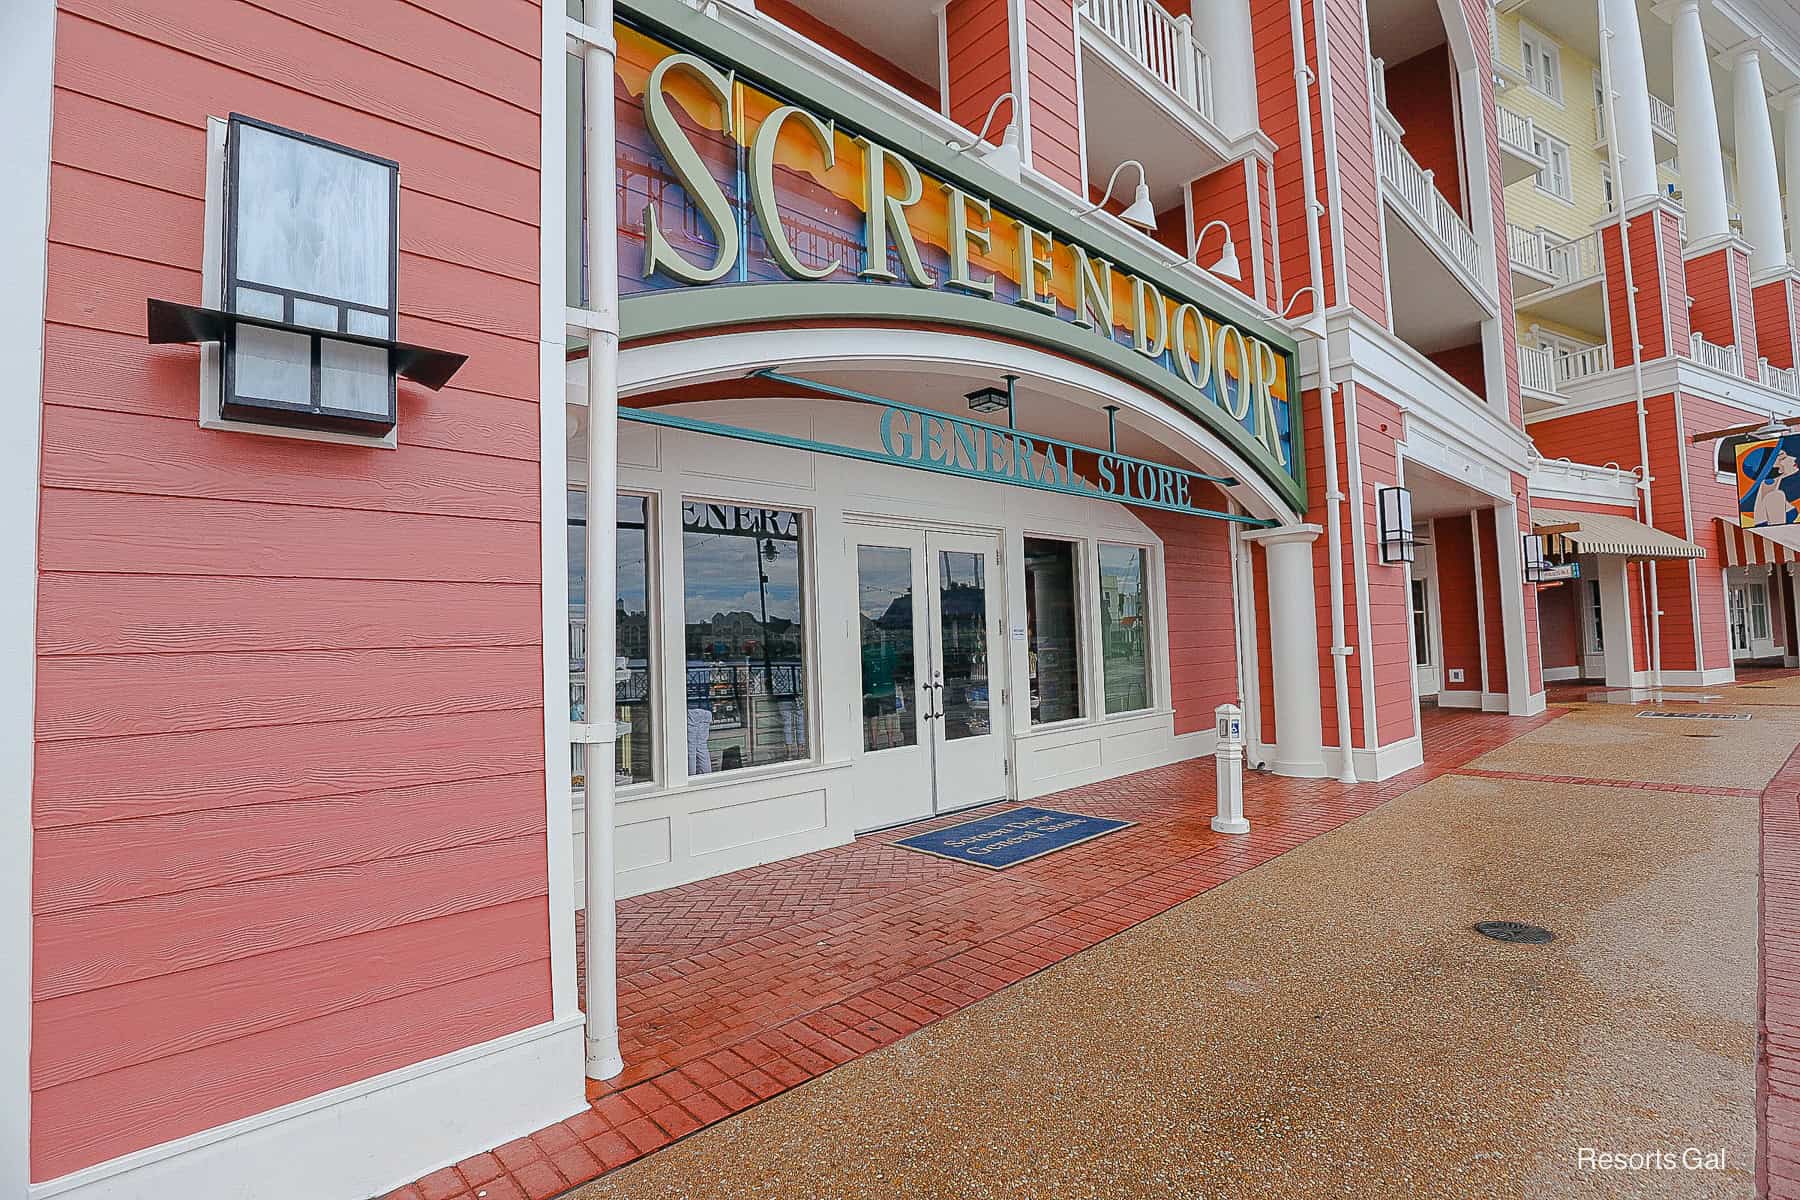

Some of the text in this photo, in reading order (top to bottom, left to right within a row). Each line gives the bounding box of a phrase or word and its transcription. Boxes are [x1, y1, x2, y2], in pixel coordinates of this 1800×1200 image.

[643, 53, 1287, 467] SCREEN DOOR
[880, 407, 1193, 508] GENERAL STORE
[944, 815, 1056, 847] Screen Door
[966, 819, 1087, 855] General Store
